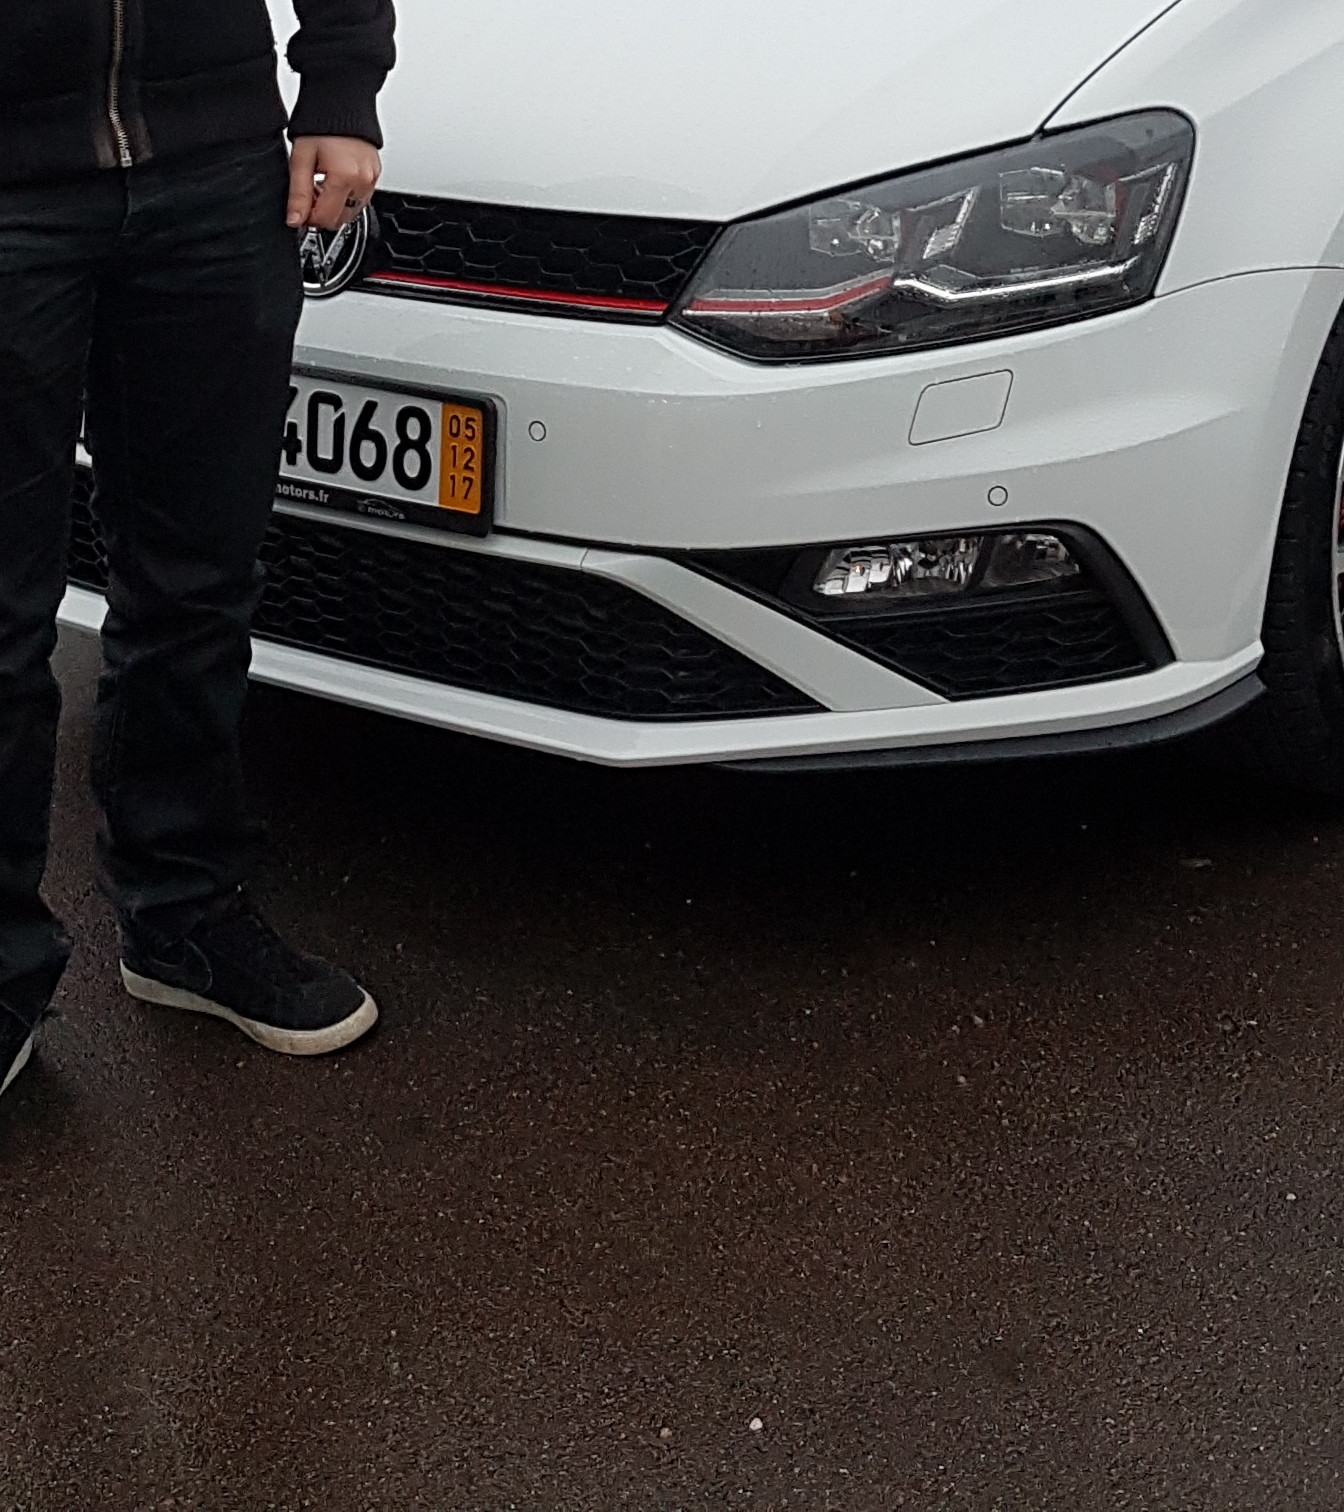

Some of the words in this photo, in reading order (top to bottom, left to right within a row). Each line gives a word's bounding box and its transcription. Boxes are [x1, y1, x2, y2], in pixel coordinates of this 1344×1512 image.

[448, 414, 477, 442] 05
[450, 444, 476, 473] 12
[449, 473, 475, 501] 17
